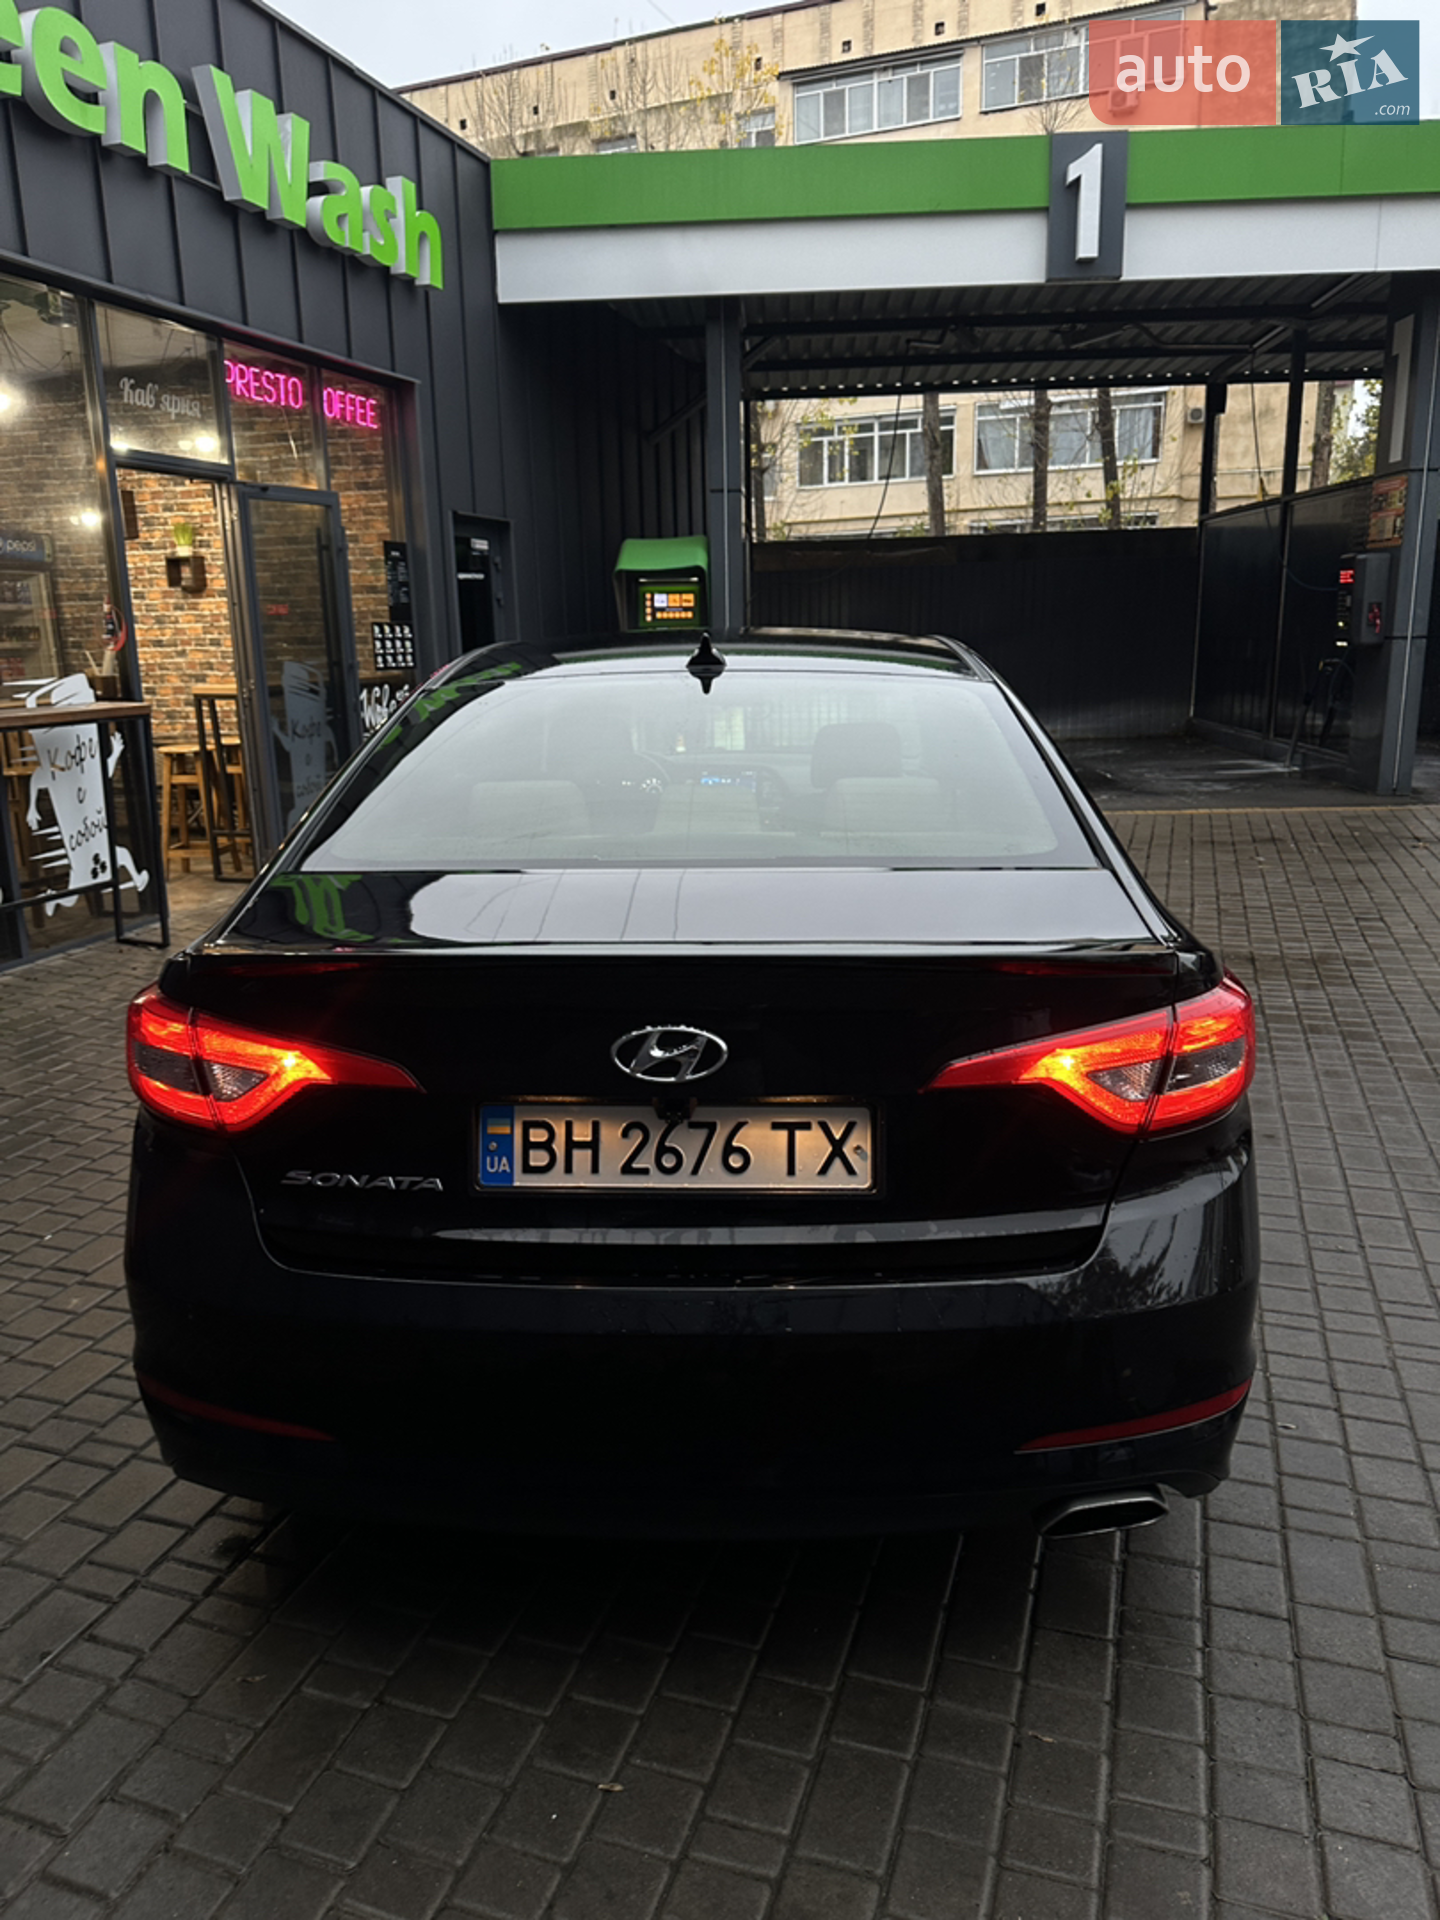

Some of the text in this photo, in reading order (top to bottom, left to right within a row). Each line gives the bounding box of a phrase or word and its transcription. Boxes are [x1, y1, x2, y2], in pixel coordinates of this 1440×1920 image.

[192, 64, 444, 290] Wash
[1064, 142, 1104, 263] 1
[1388, 313, 1415, 463] 1
[6, 539, 37, 554] pepsi
[486, 1156, 511, 1174] UA
[521, 1119, 859, 1177] BH 2676 TX
[280, 1169, 445, 1192] SONATA
